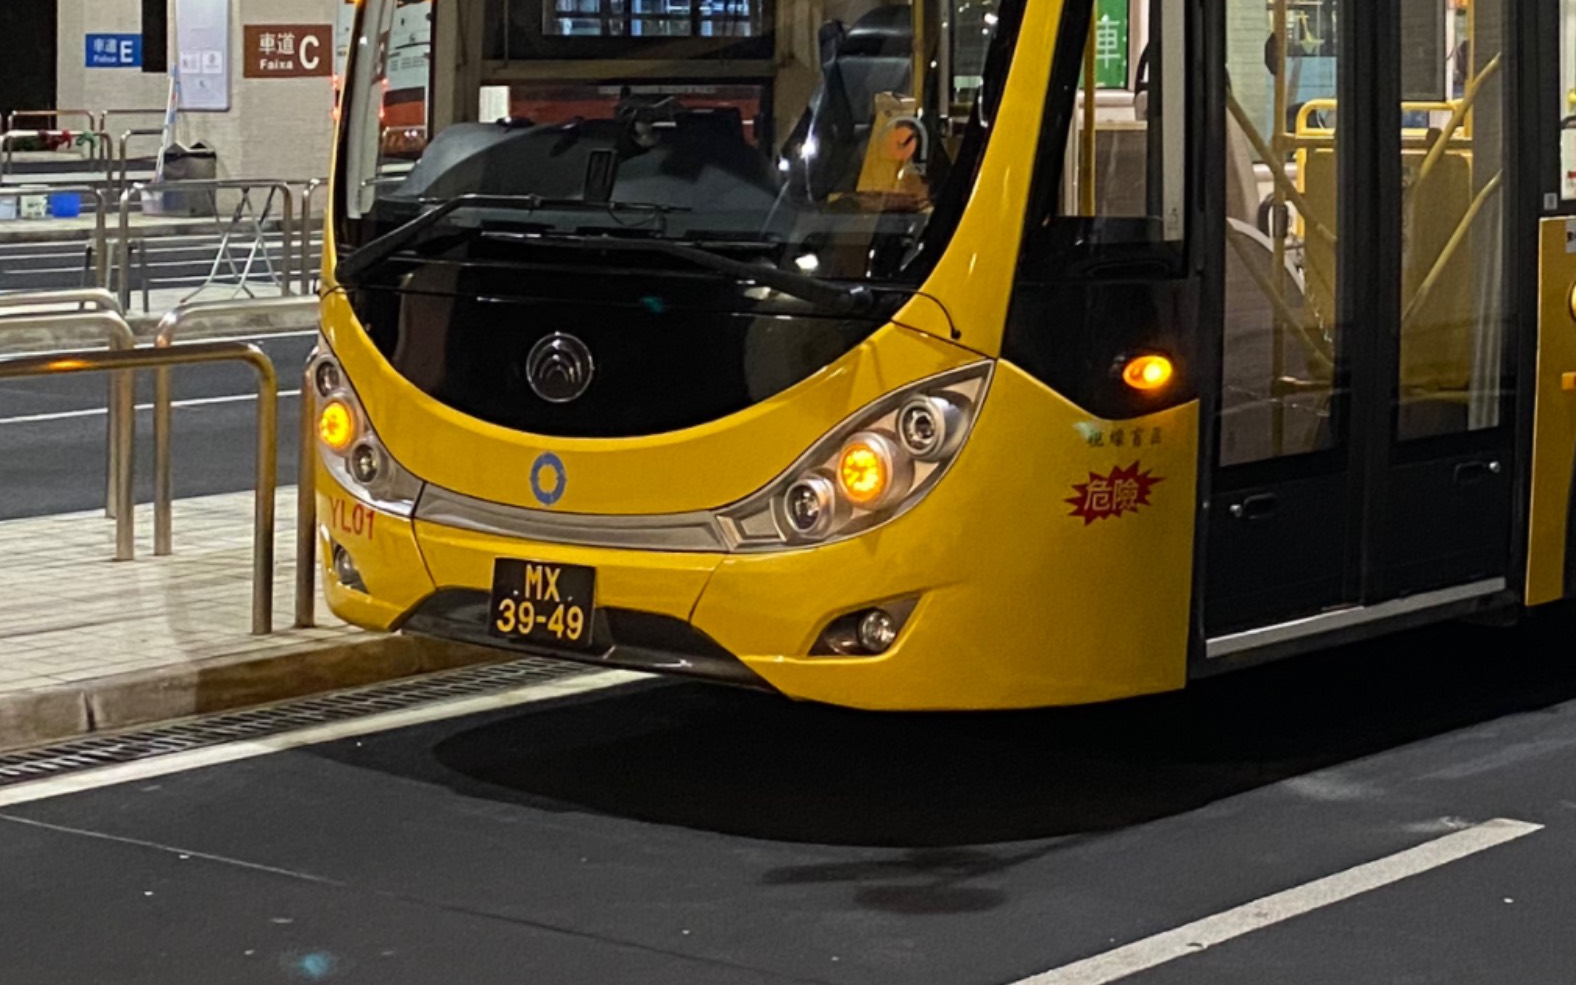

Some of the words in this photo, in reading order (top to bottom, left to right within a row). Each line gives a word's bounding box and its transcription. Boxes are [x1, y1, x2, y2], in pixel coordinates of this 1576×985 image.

[120, 40, 134, 63] E
[259, 32, 295, 55] 車道
[300, 35, 319, 69] C
[259, 59, 293, 70] Faixa
[1083, 479, 1139, 511] 危險
[330, 496, 375, 540] YL01
[525, 564, 561, 602] MX
[496, 598, 584, 640] 39-49
